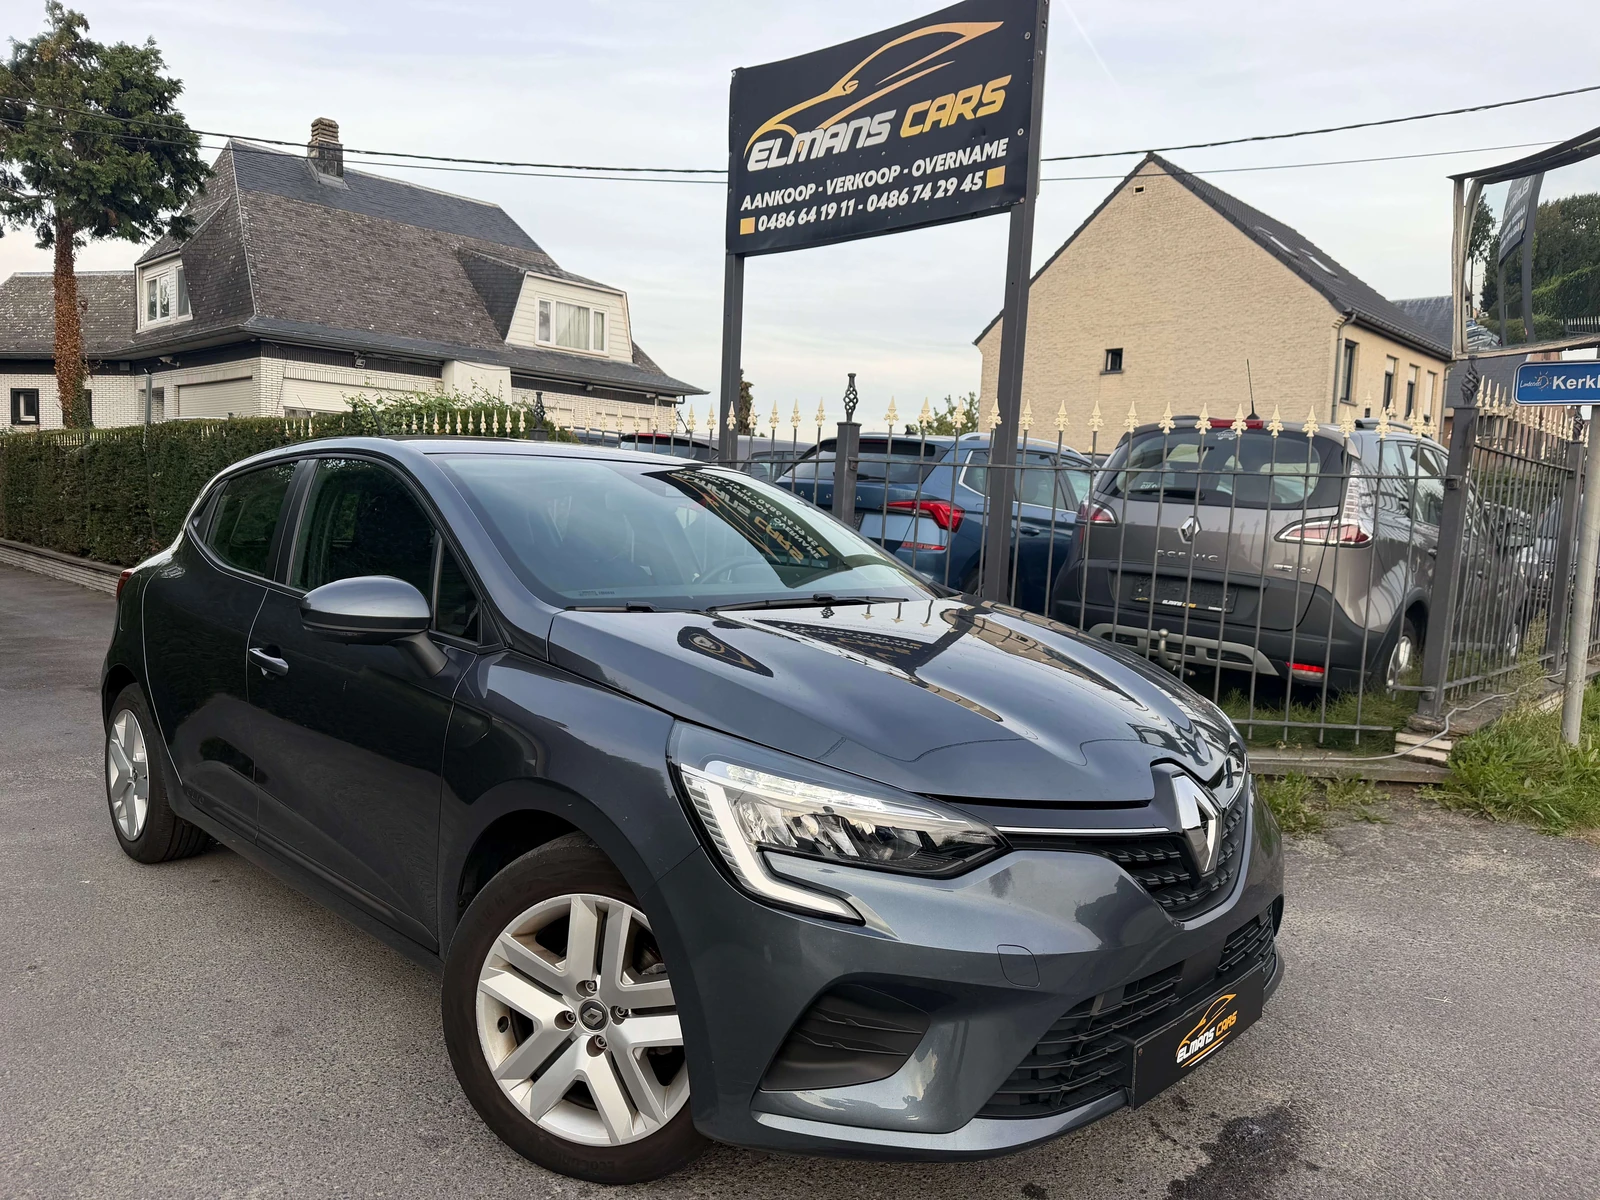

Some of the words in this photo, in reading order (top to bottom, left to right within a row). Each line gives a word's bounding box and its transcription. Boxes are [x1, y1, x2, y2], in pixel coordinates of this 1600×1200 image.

[747, 109, 896, 172] ELMANS
[900, 74, 1012, 138] CARS
[740, 183, 816, 211] AANKOOP
[826, 165, 901, 196] VERKOOP
[911, 138, 1009, 177] OVERNAME
[757, 209, 795, 231] 0486
[798, 205, 817, 224] 64
[820, 201, 837, 219] 19
[839, 198, 855, 216] 11
[866, 187, 910, 213] 0486
[911, 183, 933, 204] 74
[934, 177, 958, 199] 29
[959, 171, 984, 192] 45
[186, 788, 205, 805] CLIO
[1176, 1026, 1216, 1064] ELMANS
[1215, 1010, 1238, 1037] CARS
